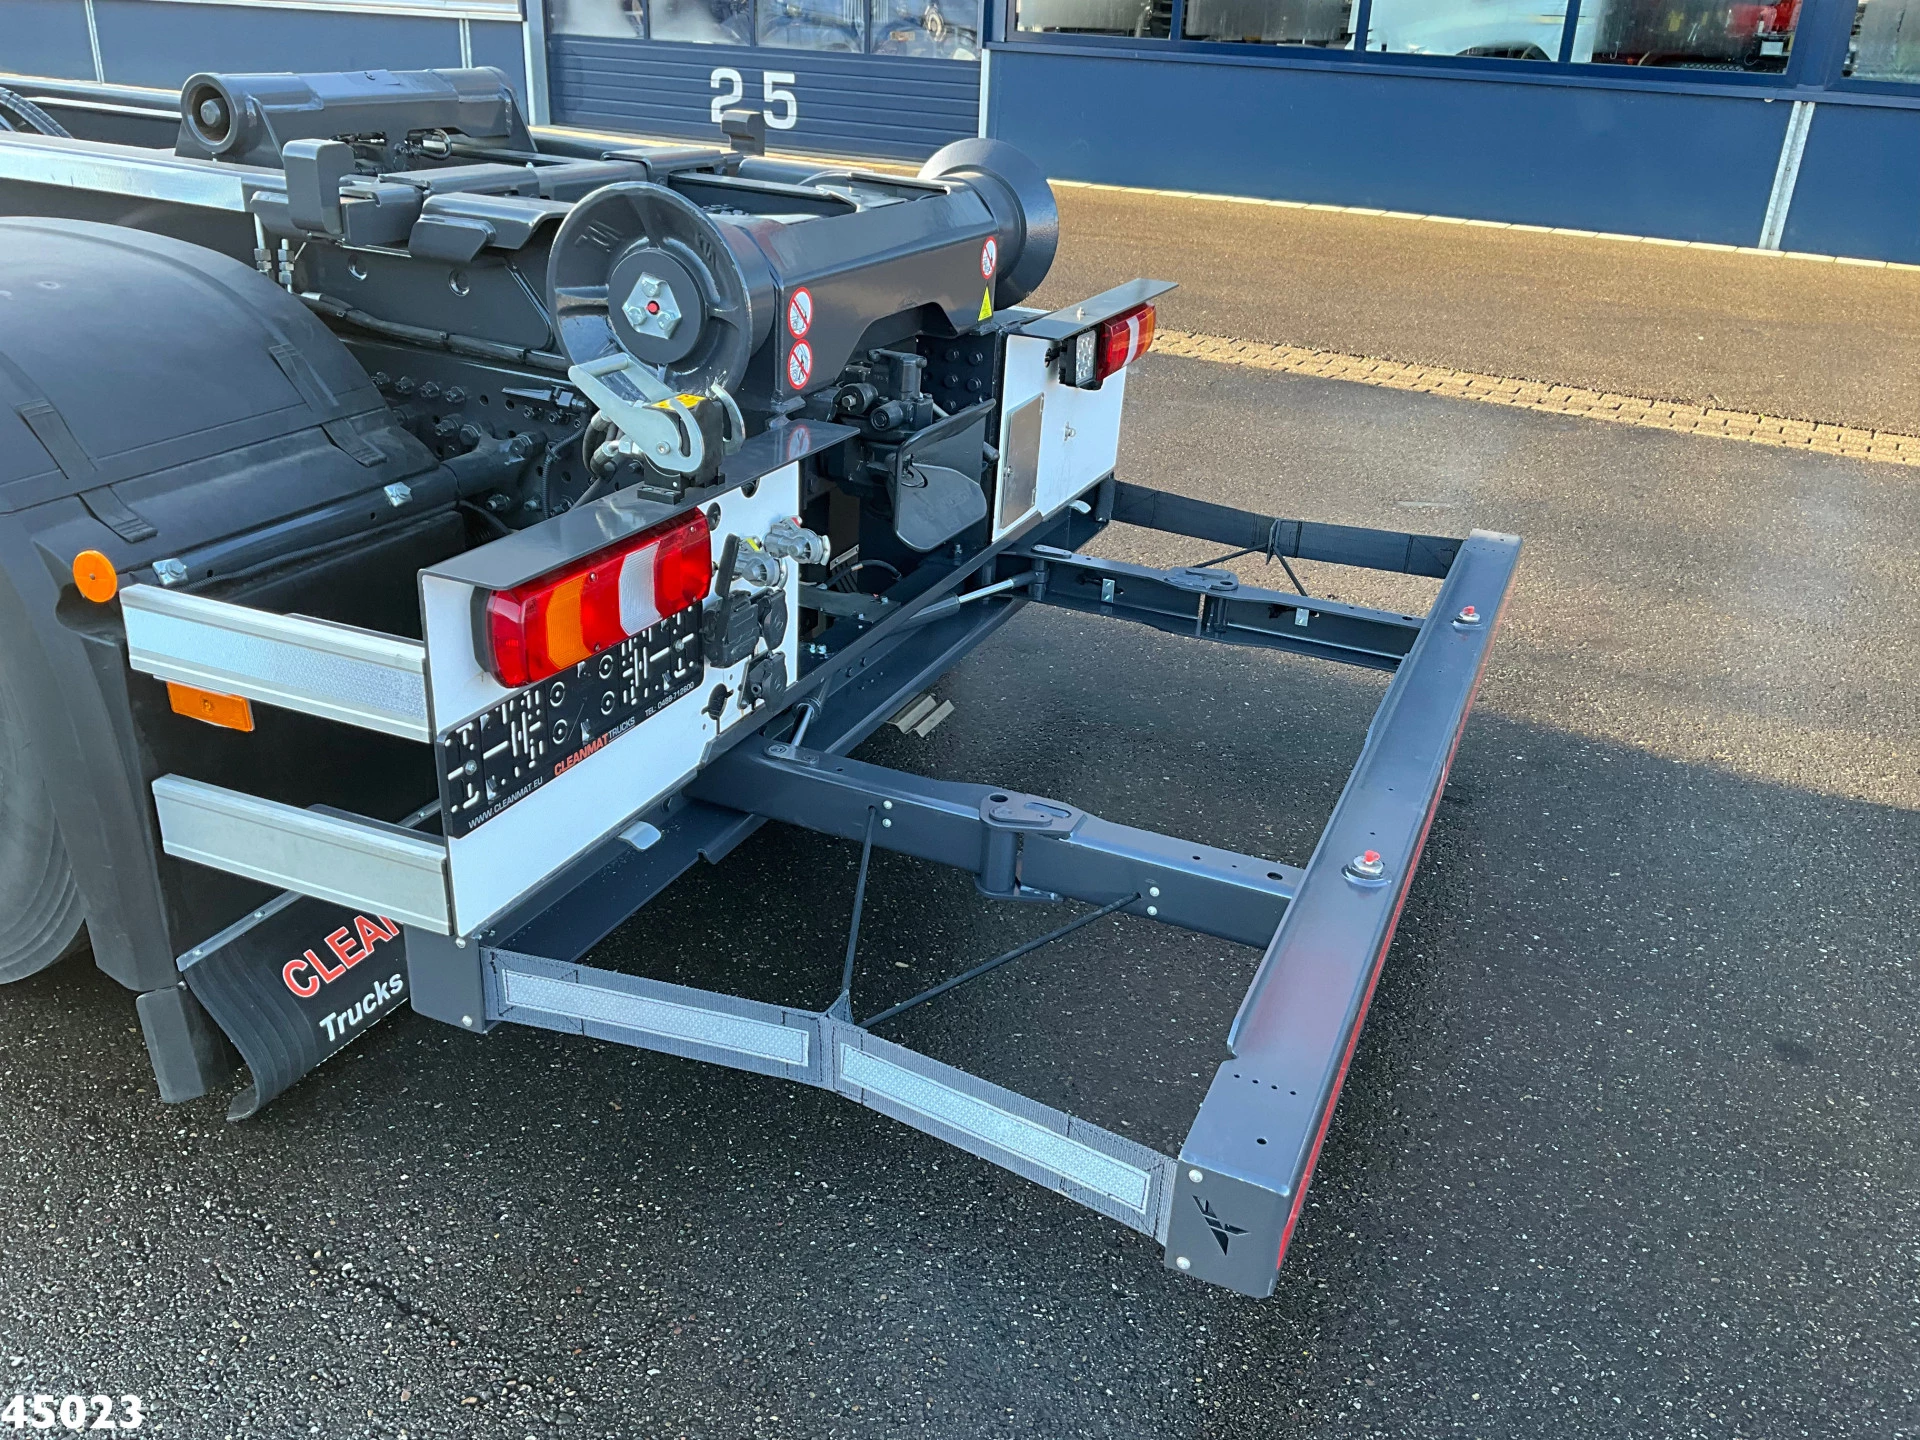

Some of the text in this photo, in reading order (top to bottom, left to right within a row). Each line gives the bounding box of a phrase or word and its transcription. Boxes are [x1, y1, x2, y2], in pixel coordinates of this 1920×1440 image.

[710, 67, 797, 130] 25
[467, 775, 543, 829] WWW.CLEANMAT.EU
[318, 973, 404, 1043] Trucks
